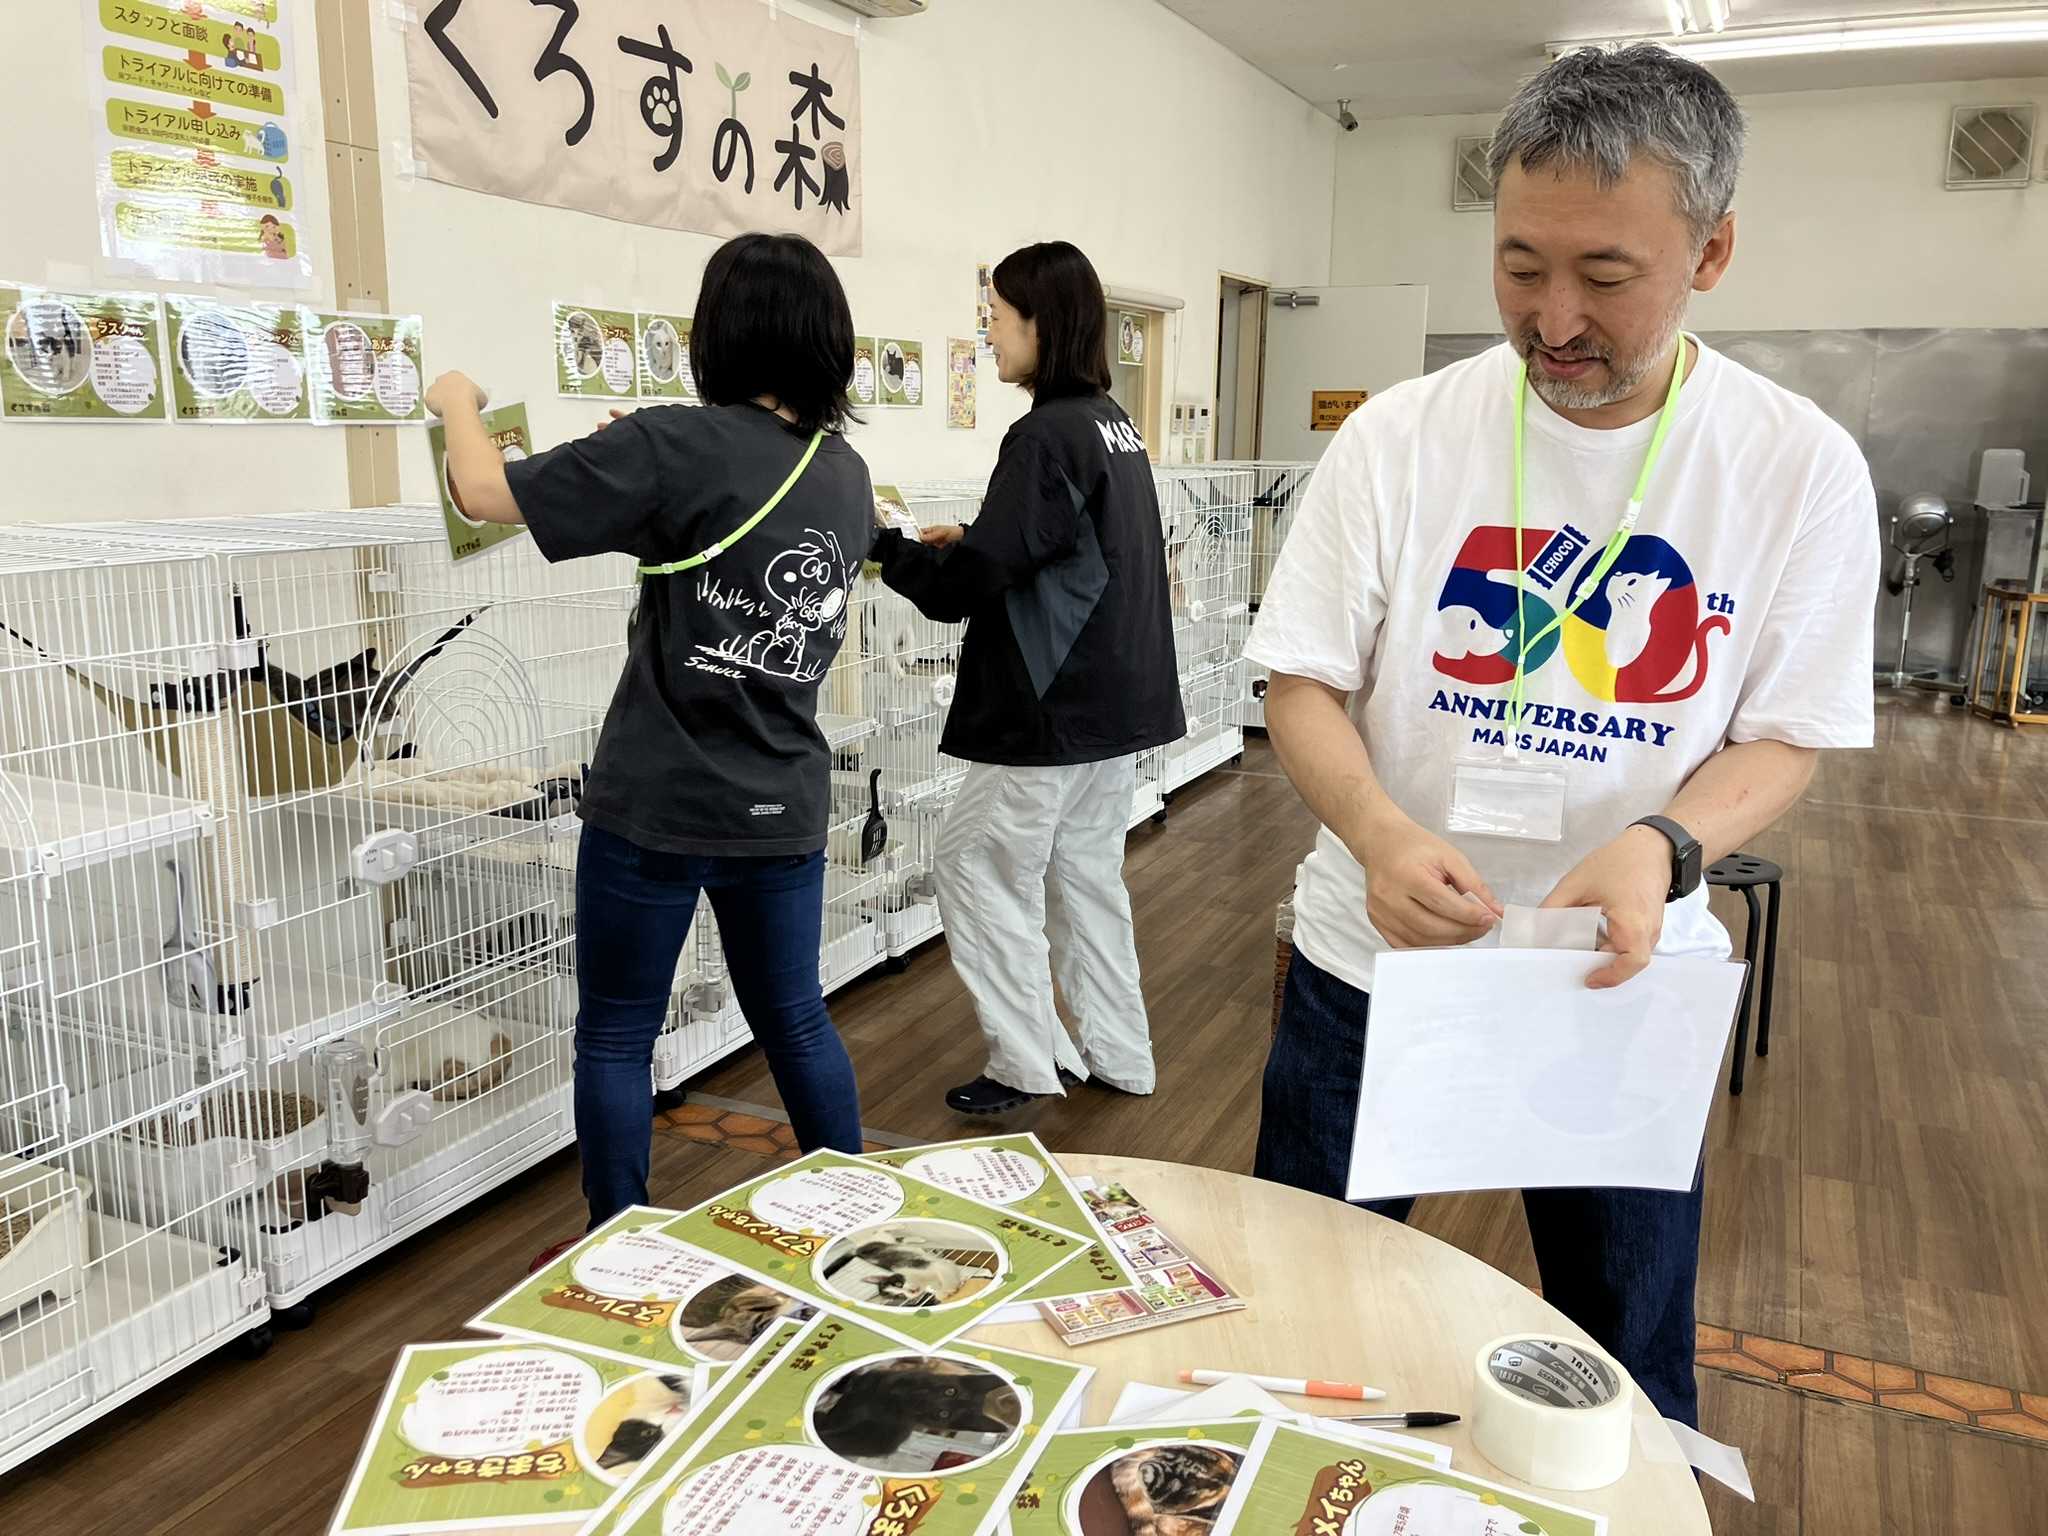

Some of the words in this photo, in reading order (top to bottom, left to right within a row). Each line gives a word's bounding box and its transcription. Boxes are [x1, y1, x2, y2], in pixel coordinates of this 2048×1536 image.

[114, 6, 209, 43] スタッフと面談
[120, 54, 273, 103] トライアルに向けての準備
[124, 106, 241, 140] トライアル申し込み
[424, 0, 851, 216] くろすの森
[1542, 540, 1575, 577] CHOCO
[1706, 593, 1736, 615] th
[1428, 689, 1676, 747] ANNIVERSARY
[1535, 737, 1608, 763] JAPAN
[711, 1204, 829, 1258] マフィンちゃん
[566, 1285, 672, 1328] スフレちゃん
[1571, 1355, 1599, 1386] ASKUL
[402, 1453, 566, 1480] ちまきちゃん
